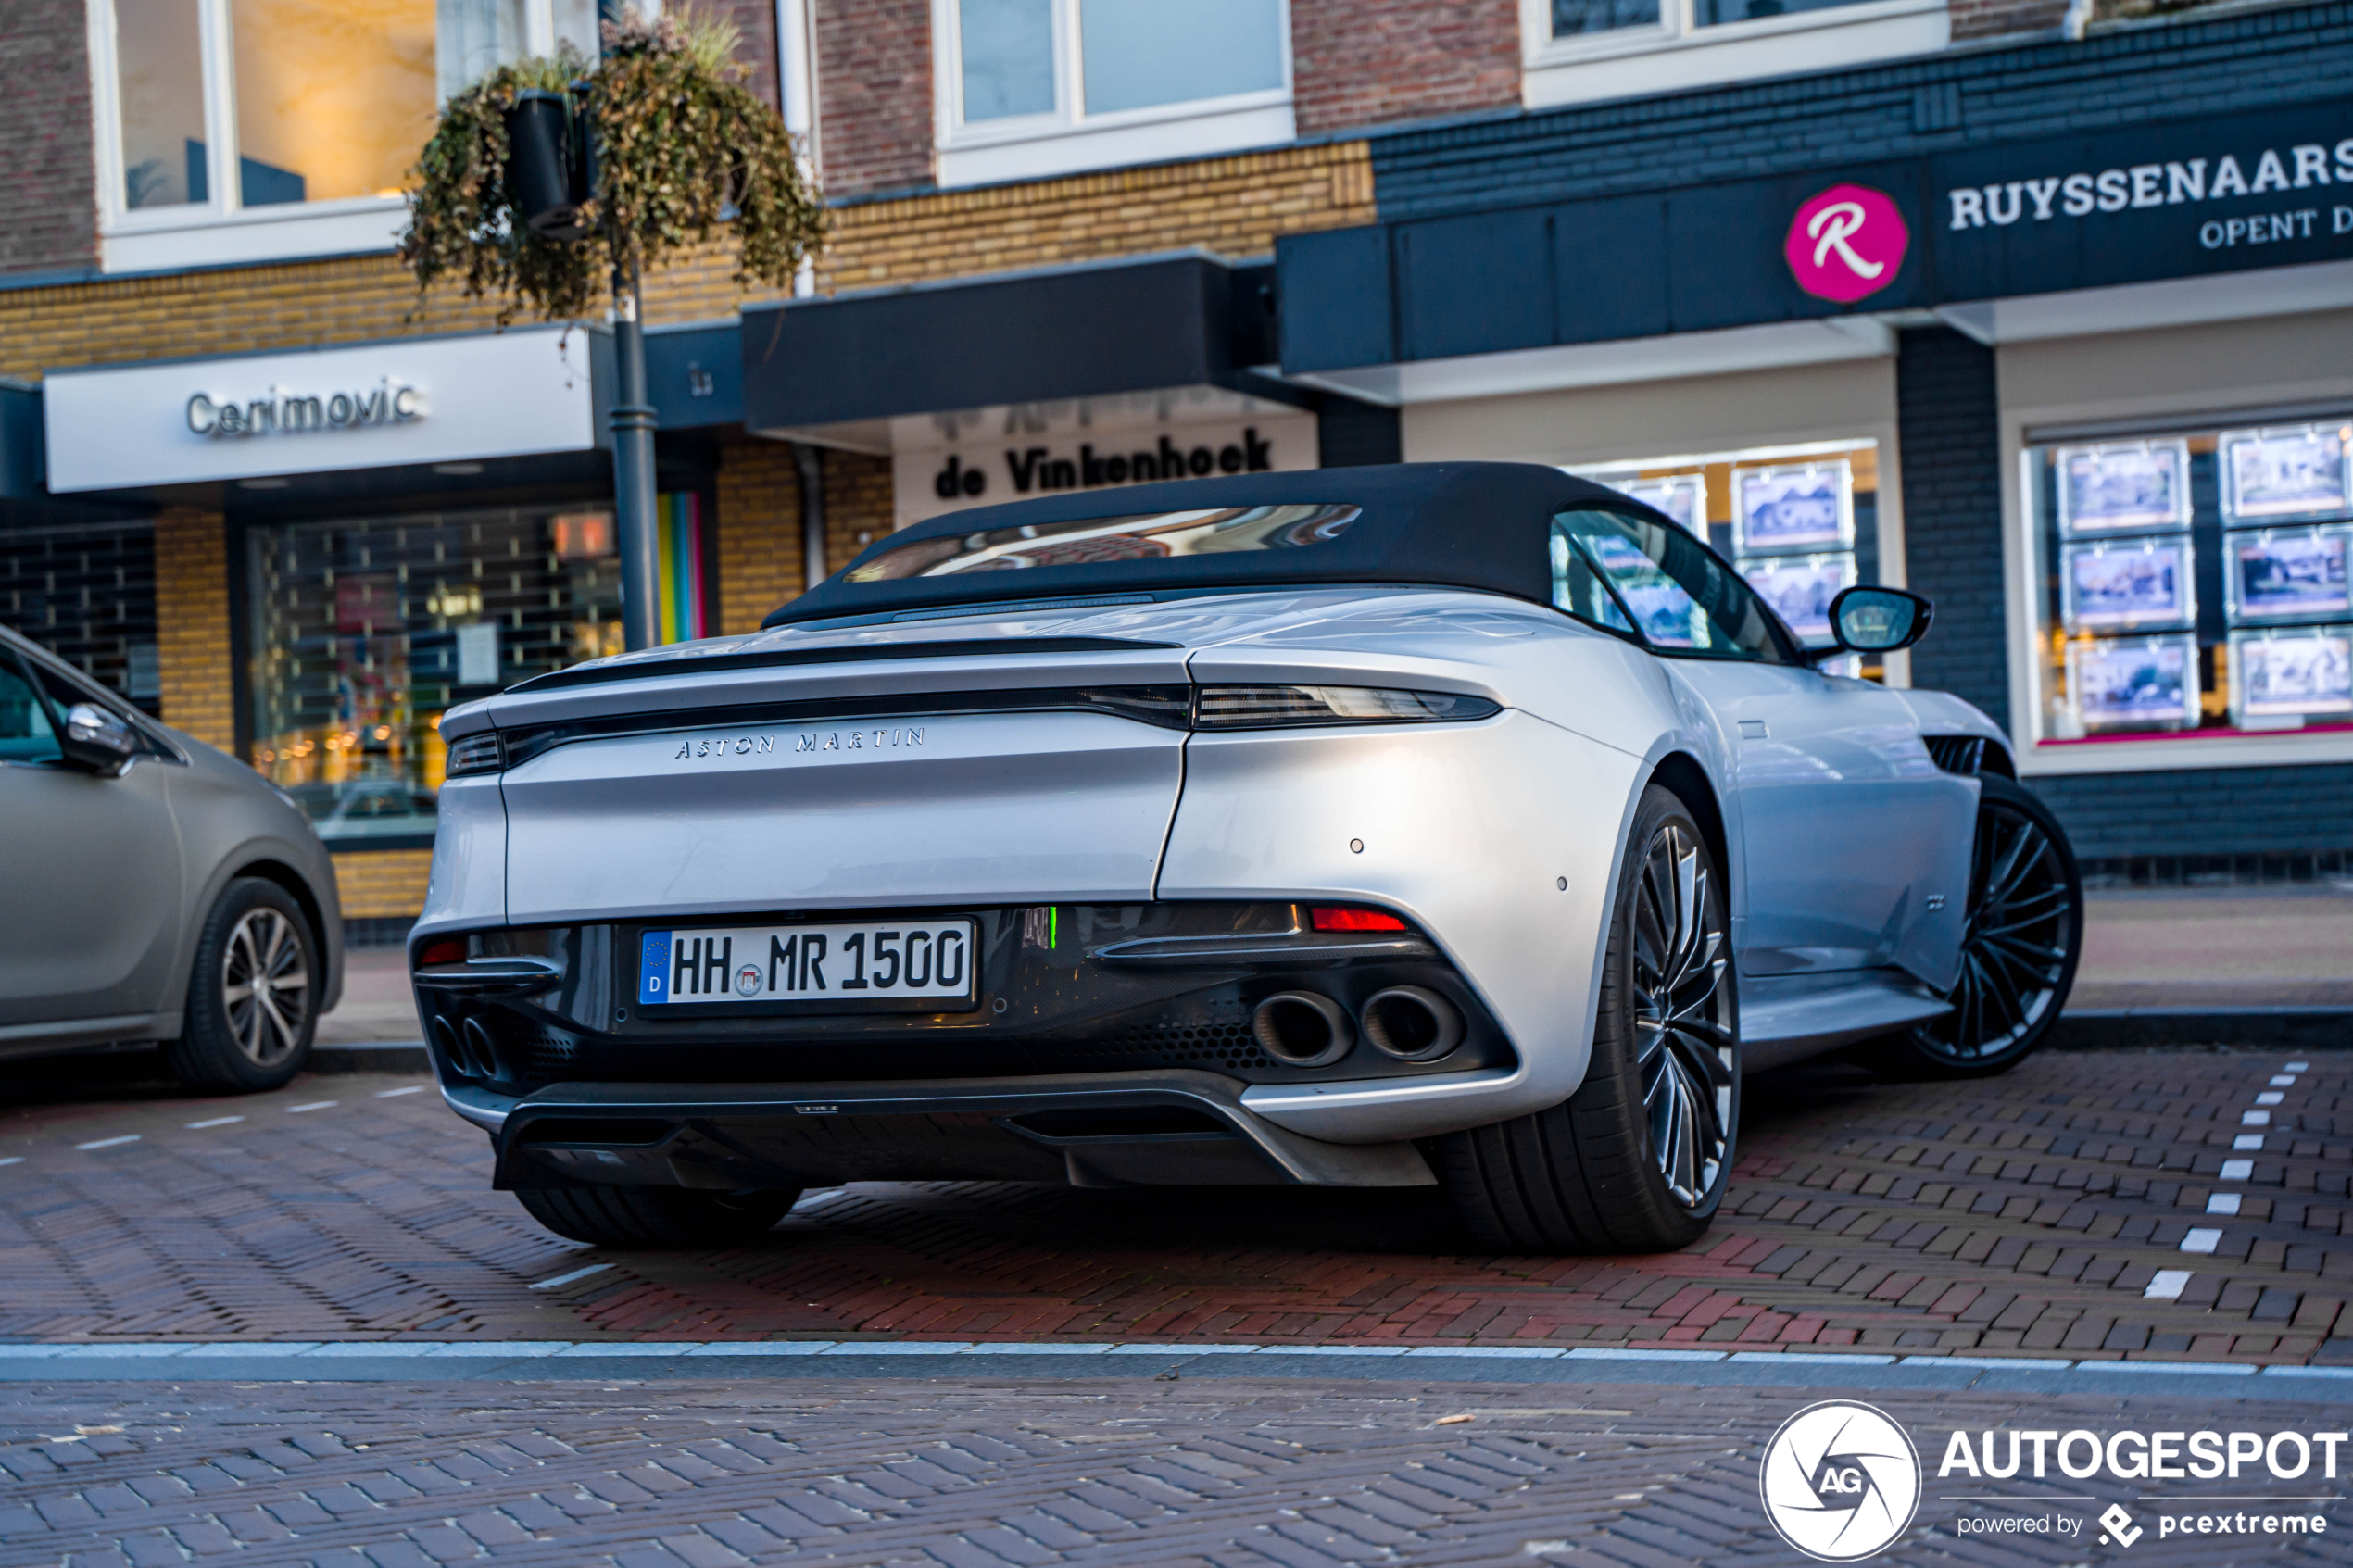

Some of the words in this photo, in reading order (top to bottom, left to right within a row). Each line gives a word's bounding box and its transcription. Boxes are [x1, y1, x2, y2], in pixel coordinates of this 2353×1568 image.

[1948, 138, 2353, 231] RUYSSENAARS
[1807, 202, 1884, 280] R
[2199, 207, 2318, 249] OPENT
[187, 375, 420, 435] Cerimovic
[935, 455, 986, 498] de
[1005, 427, 1272, 493] Vinkenhoek
[674, 735, 775, 759] ASTON
[795, 727, 925, 752] MARTIN
[649, 976, 661, 992] D
[673, 936, 733, 994] HH
[769, 933, 828, 991] MR
[842, 929, 964, 990] 1500
